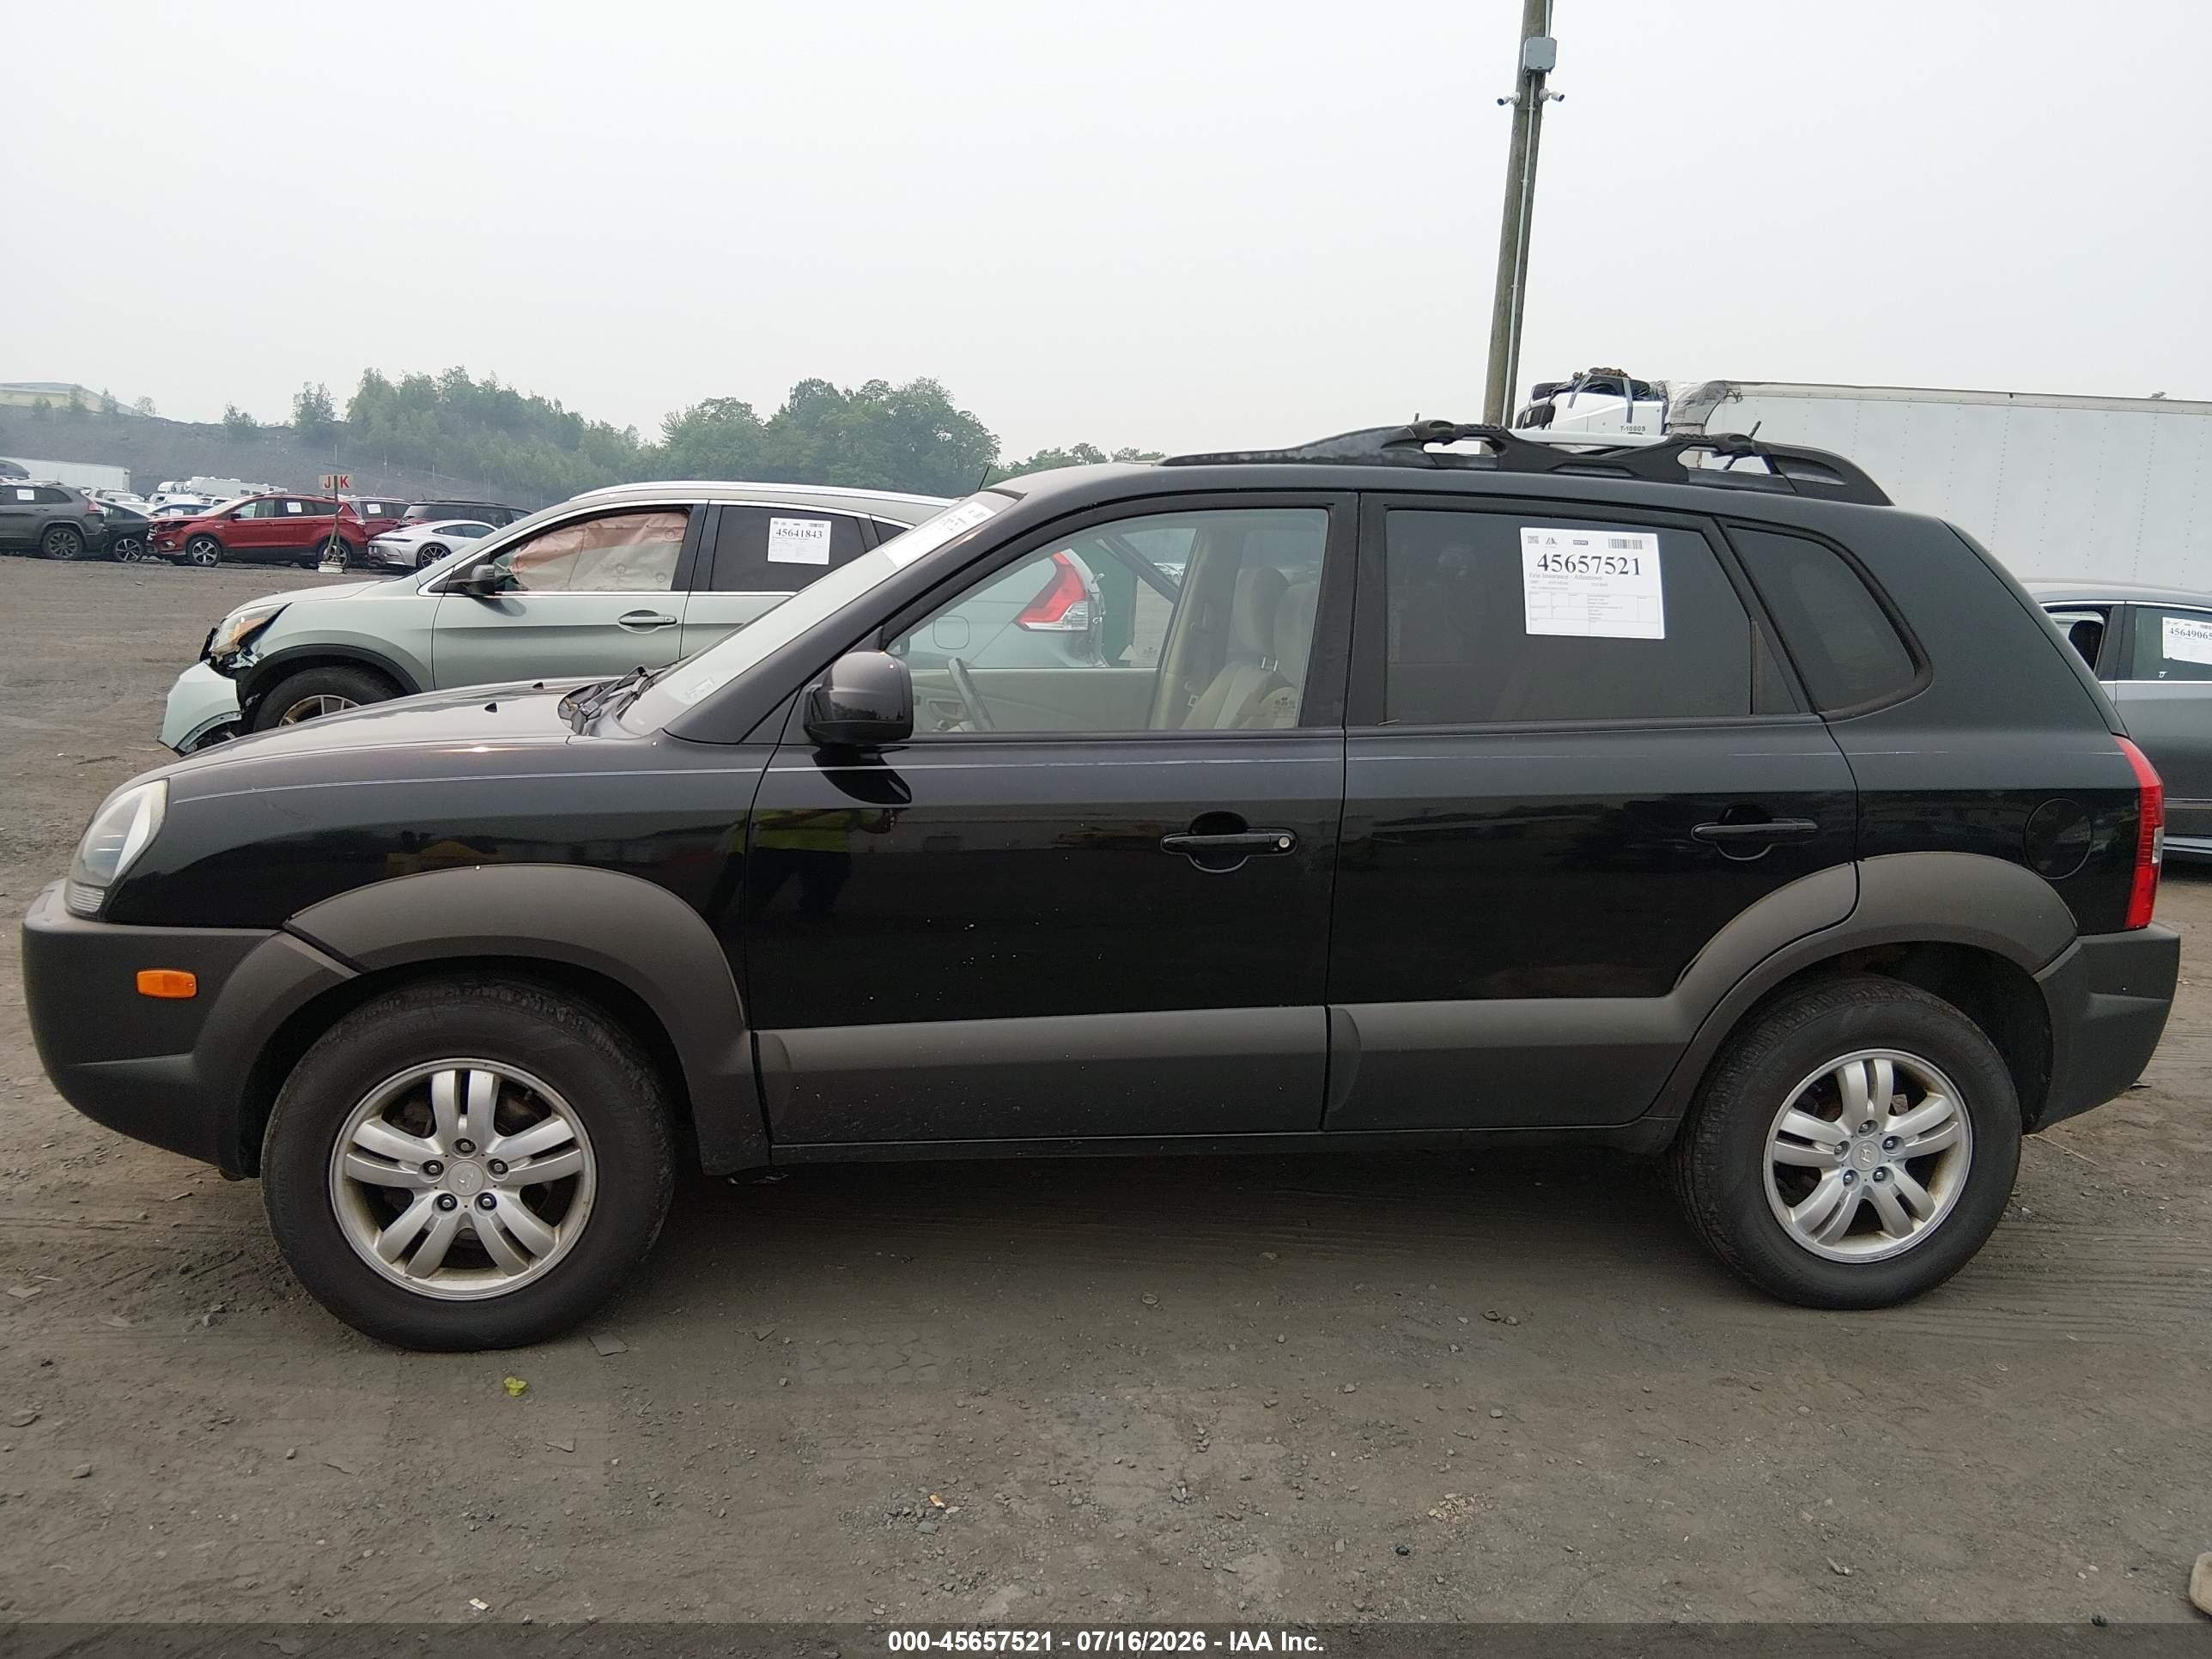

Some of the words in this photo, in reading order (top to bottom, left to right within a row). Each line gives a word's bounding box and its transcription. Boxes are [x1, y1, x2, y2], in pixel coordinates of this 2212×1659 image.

[324, 475, 331, 489] J
[340, 475, 349, 489] K
[775, 528, 823, 539] 45641843
[1536, 553, 1643, 576] 45657521
